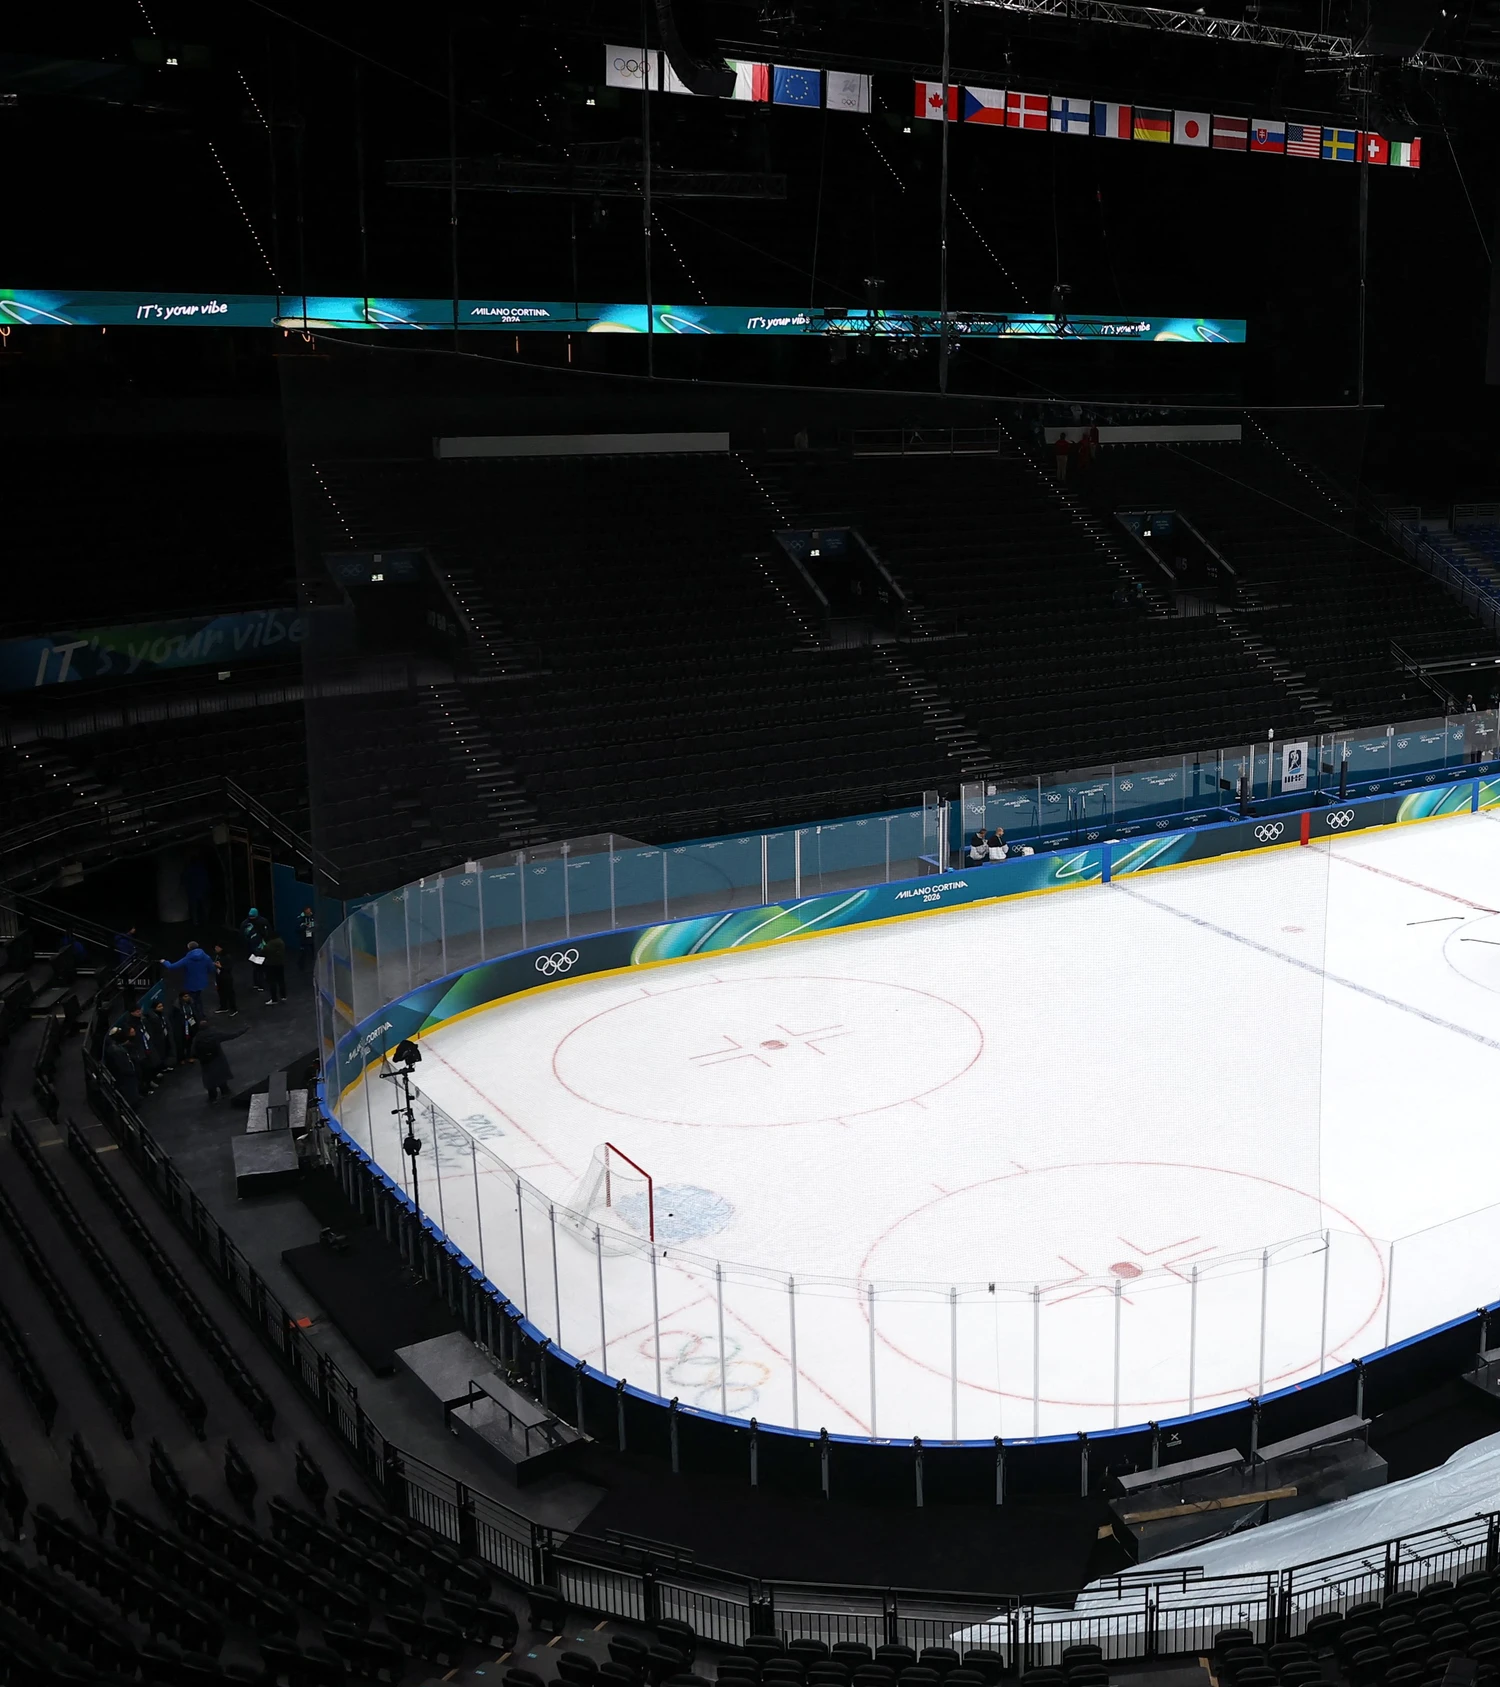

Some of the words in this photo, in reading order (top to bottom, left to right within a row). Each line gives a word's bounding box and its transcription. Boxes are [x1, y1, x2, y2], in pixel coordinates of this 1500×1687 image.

[136, 304, 163, 320] IT's
[163, 304, 199, 320] your
[201, 300, 228, 314] vibe
[470, 307, 510, 316] MILANO
[511, 308, 551, 317] CORTINA
[747, 316, 766, 329] IT's
[766, 317, 791, 330] your
[35, 636, 113, 687] IT's
[124, 627, 224, 675] your
[233, 612, 309, 651] vibe
[1284, 773, 1305, 783] IIHF
[894, 887, 931, 900] MILANO
[932, 880, 968, 893] CORTINA
[923, 893, 941, 902] 2026
